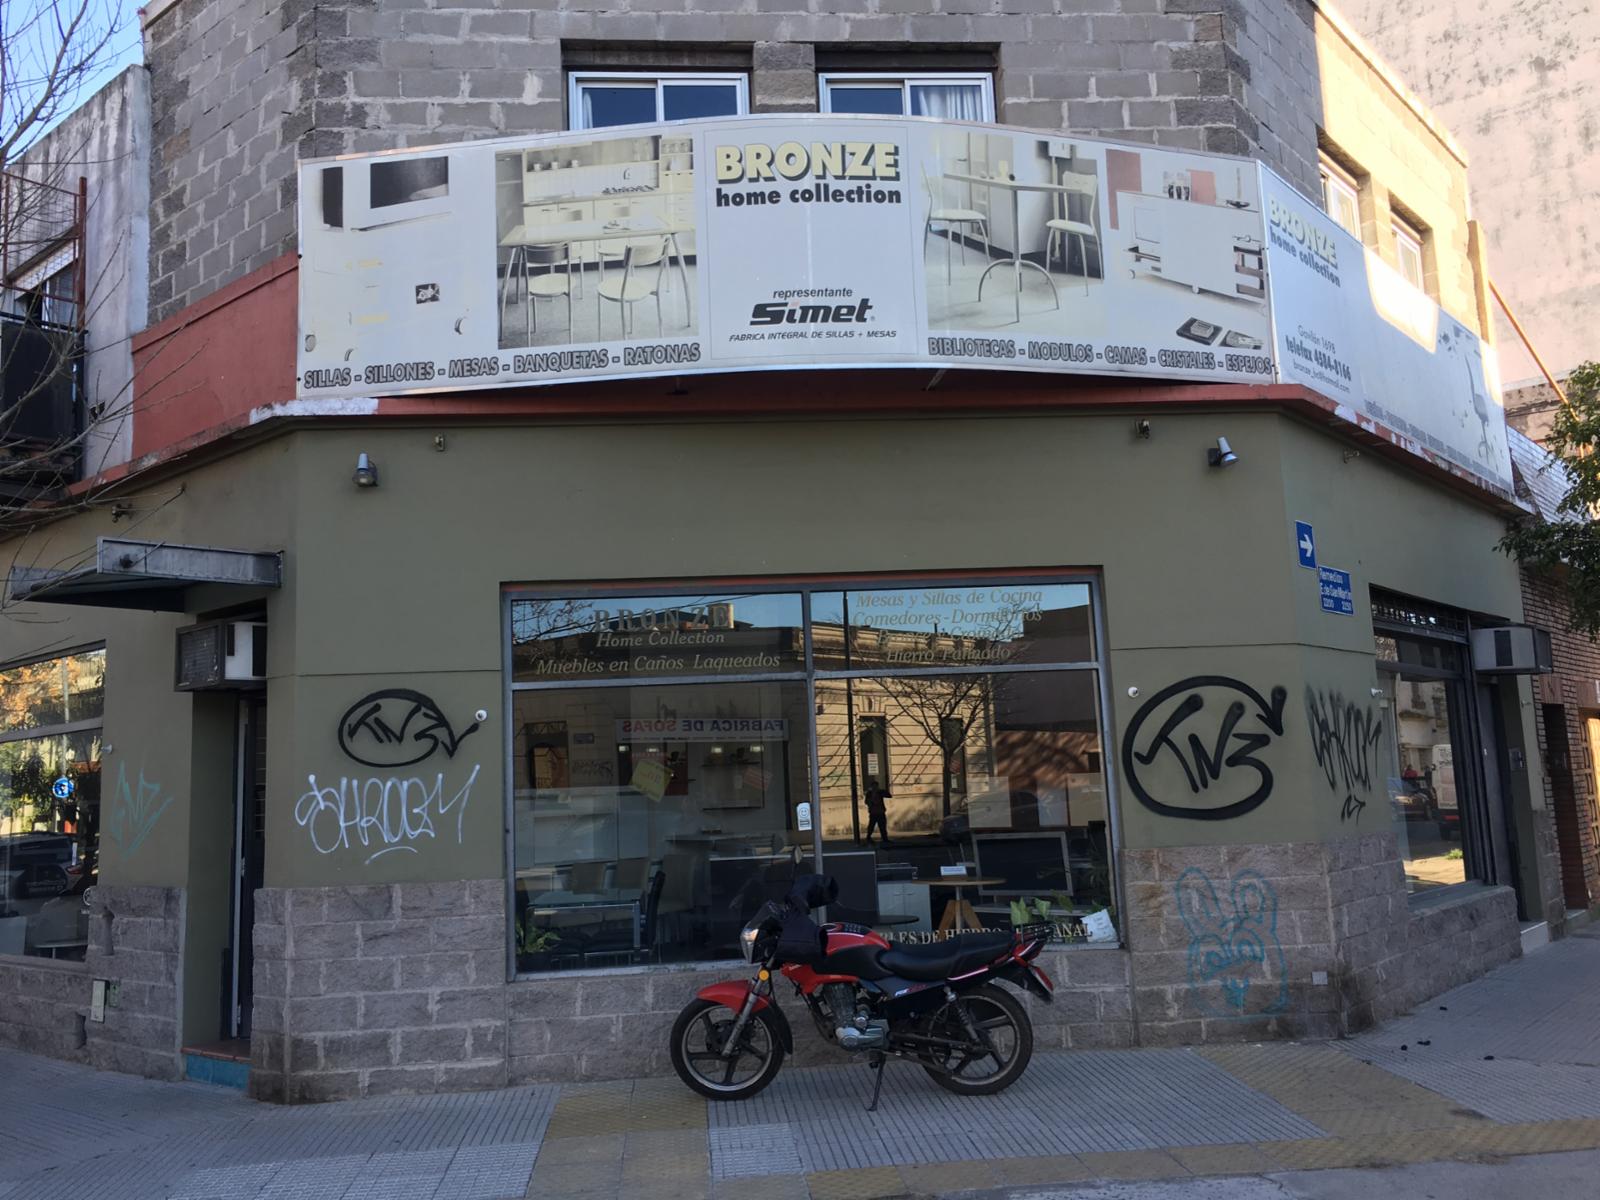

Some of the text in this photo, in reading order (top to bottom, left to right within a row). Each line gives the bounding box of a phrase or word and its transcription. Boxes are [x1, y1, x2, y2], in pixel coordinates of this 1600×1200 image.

[715, 141, 900, 184] BRONZE
[716, 183, 902, 207] home collection
[1268, 194, 1338, 270] BRONZE
[1269, 225, 1341, 288] home collection
[772, 287, 853, 300] representante
[729, 333, 765, 342] FABRICA
[767, 331, 808, 340] INTEGRAL
[825, 330, 855, 338] SILLAS
[866, 330, 897, 338] MESAS
[304, 368, 352, 389] SILLAS
[364, 361, 435, 384] SILLONES
[448, 356, 500, 378] MESAS
[513, 349, 609, 374] BANQUETAS
[624, 343, 701, 366] RATONAS
[928, 337, 1017, 358] BIBLIOTECAS
[1028, 341, 1094, 363] MODULOS
[1104, 345, 1148, 366] CAMAS
[1157, 349, 1216, 370] CRISTALES
[1225, 353, 1273, 375] ESPEJOS
[856, 587, 1043, 609] Mesas y Sillas de Cocina
[593, 604, 728, 632] BRONZE
[852, 609, 941, 627] Comedores
[596, 630, 725, 648] Home Collection
[536, 652, 781, 675] Muebles en Caños Laqueados
[886, 649, 935, 663] Hierro
